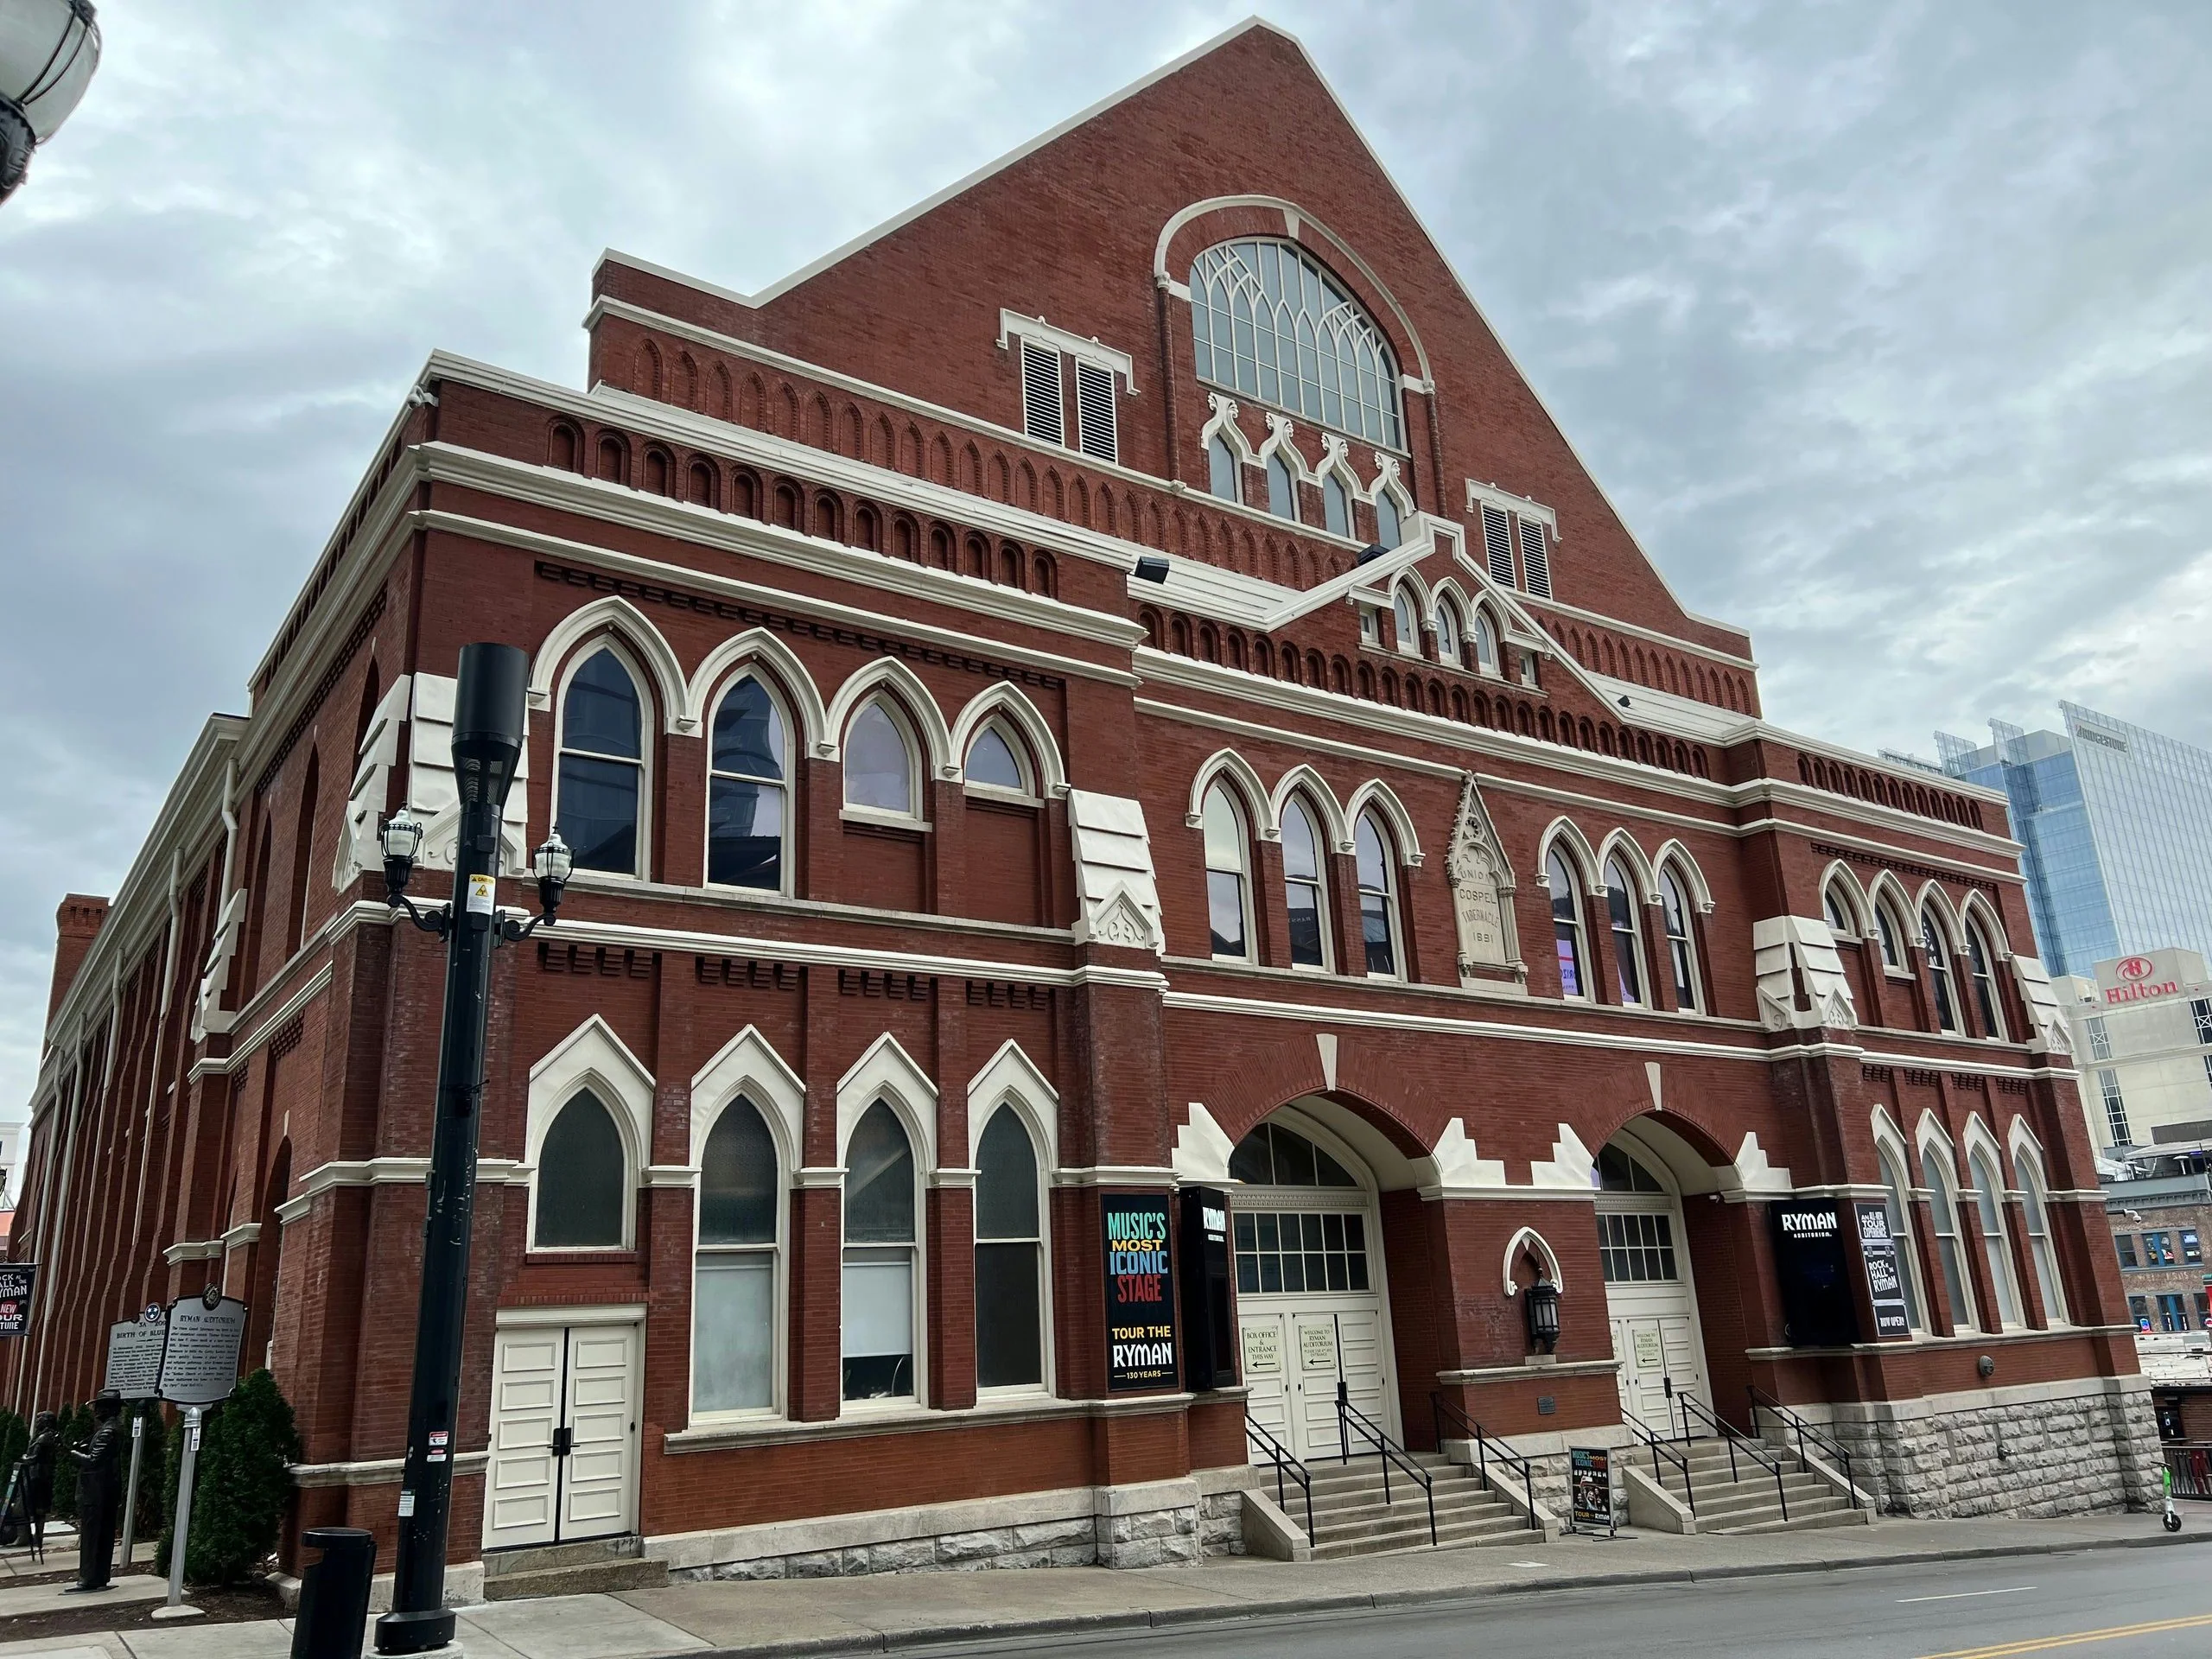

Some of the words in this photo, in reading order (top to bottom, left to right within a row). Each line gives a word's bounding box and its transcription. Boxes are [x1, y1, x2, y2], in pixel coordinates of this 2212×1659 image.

[2075, 724, 2126, 753] BRIDGESTONE
[1460, 868, 1491, 884] UNION
[1462, 909, 1499, 928] TABERNACLE
[2105, 981, 2178, 1005] Hilton
[1107, 1211, 1166, 1240] MUSIC'S
[1781, 1211, 1838, 1231] RYMAN
[1112, 1239, 1163, 1251] MOST
[1109, 1250, 1168, 1275] ICONIC
[1868, 1259, 1885, 1271] ROCK
[1870, 1268, 1888, 1281] HALL
[1873, 1274, 1898, 1293] RYMAN
[1117, 1274, 1162, 1303] STAGE
[0, 1304, 16, 1314] NEW
[1111, 1327, 1145, 1340] TOUR
[1147, 1325, 1172, 1338] THE
[1113, 1342, 1173, 1368] RYMAN
[1127, 1371, 1138, 1380] 130
[1139, 1370, 1161, 1378] YEARS
